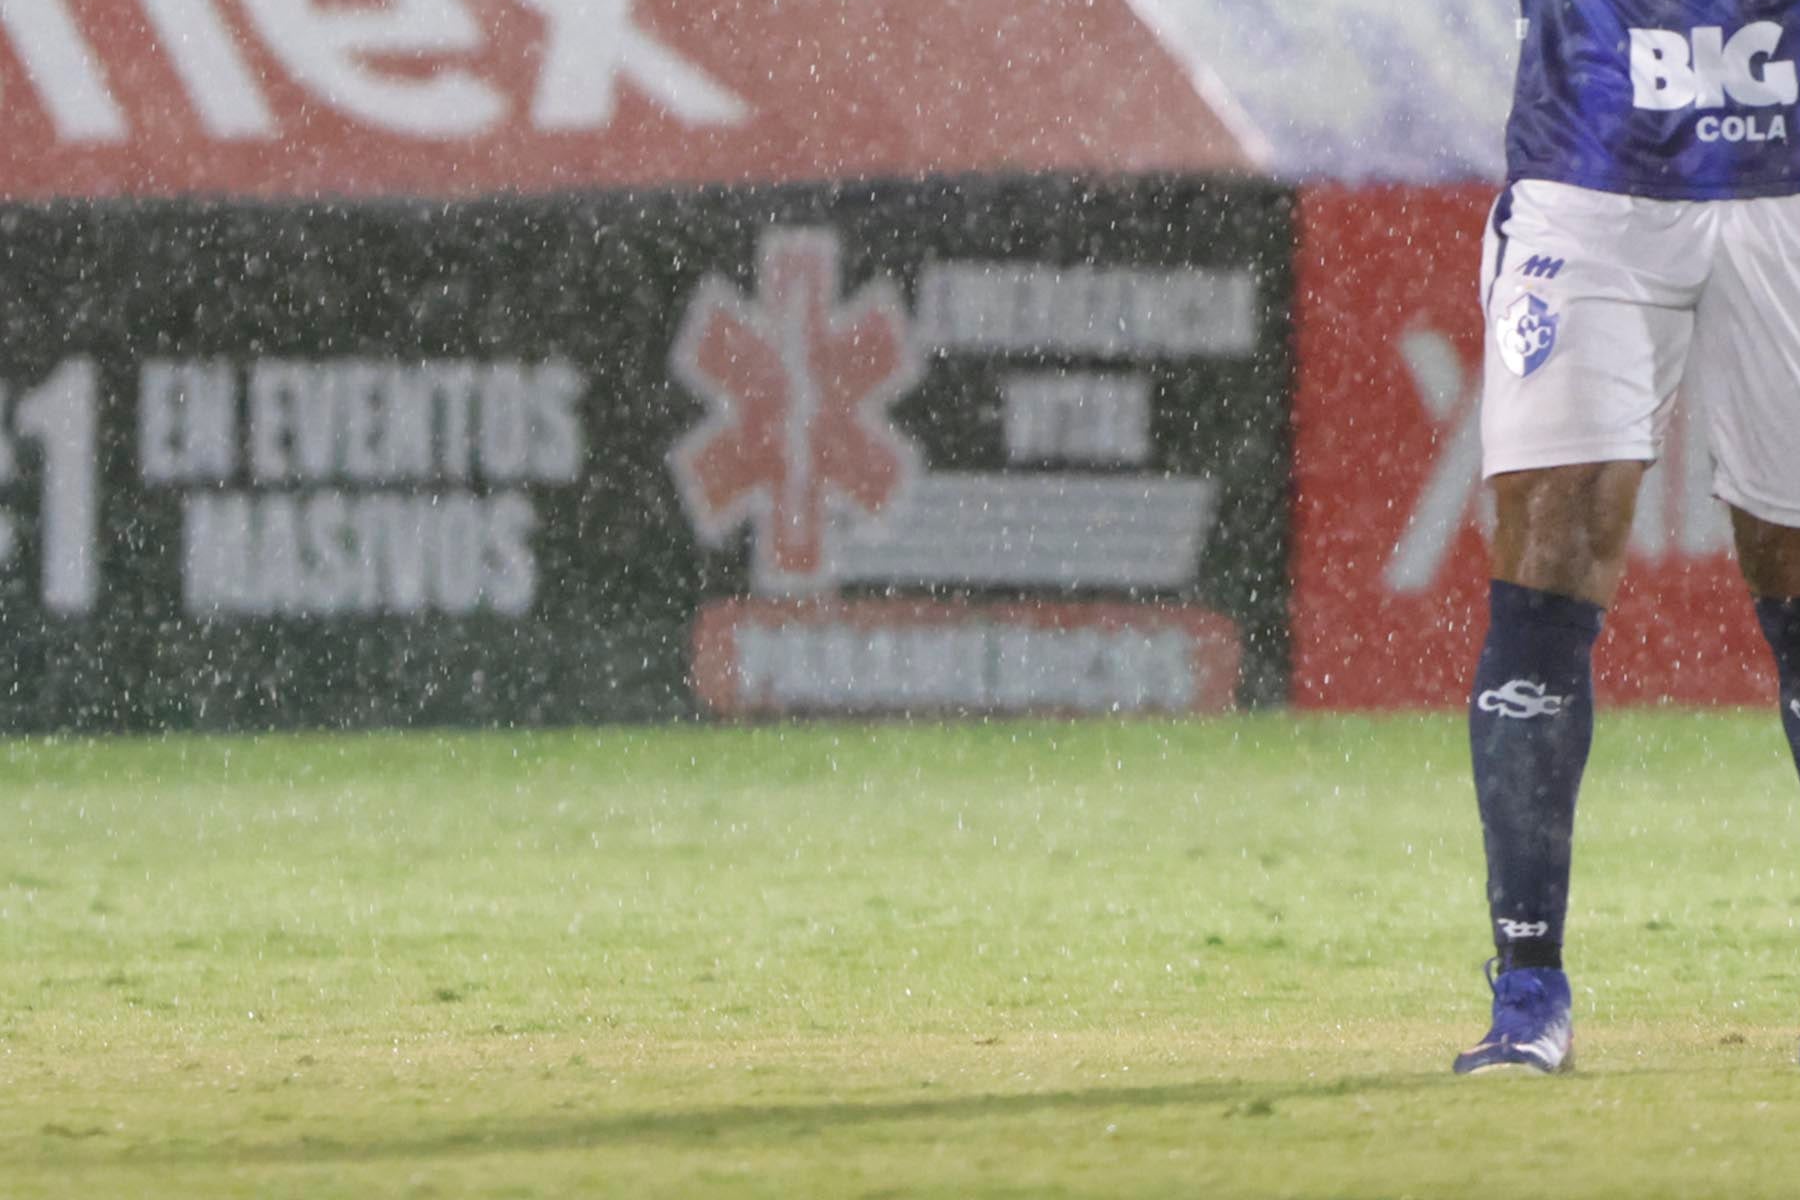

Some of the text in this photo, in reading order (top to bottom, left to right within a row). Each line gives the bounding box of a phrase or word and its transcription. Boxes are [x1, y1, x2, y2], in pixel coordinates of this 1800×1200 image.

[1629, 21, 1799, 111] BIG
[1696, 115, 1787, 142] COLA
[137, 358, 592, 484] EN EVENTOS
[182, 490, 538, 616] MASIVOS
